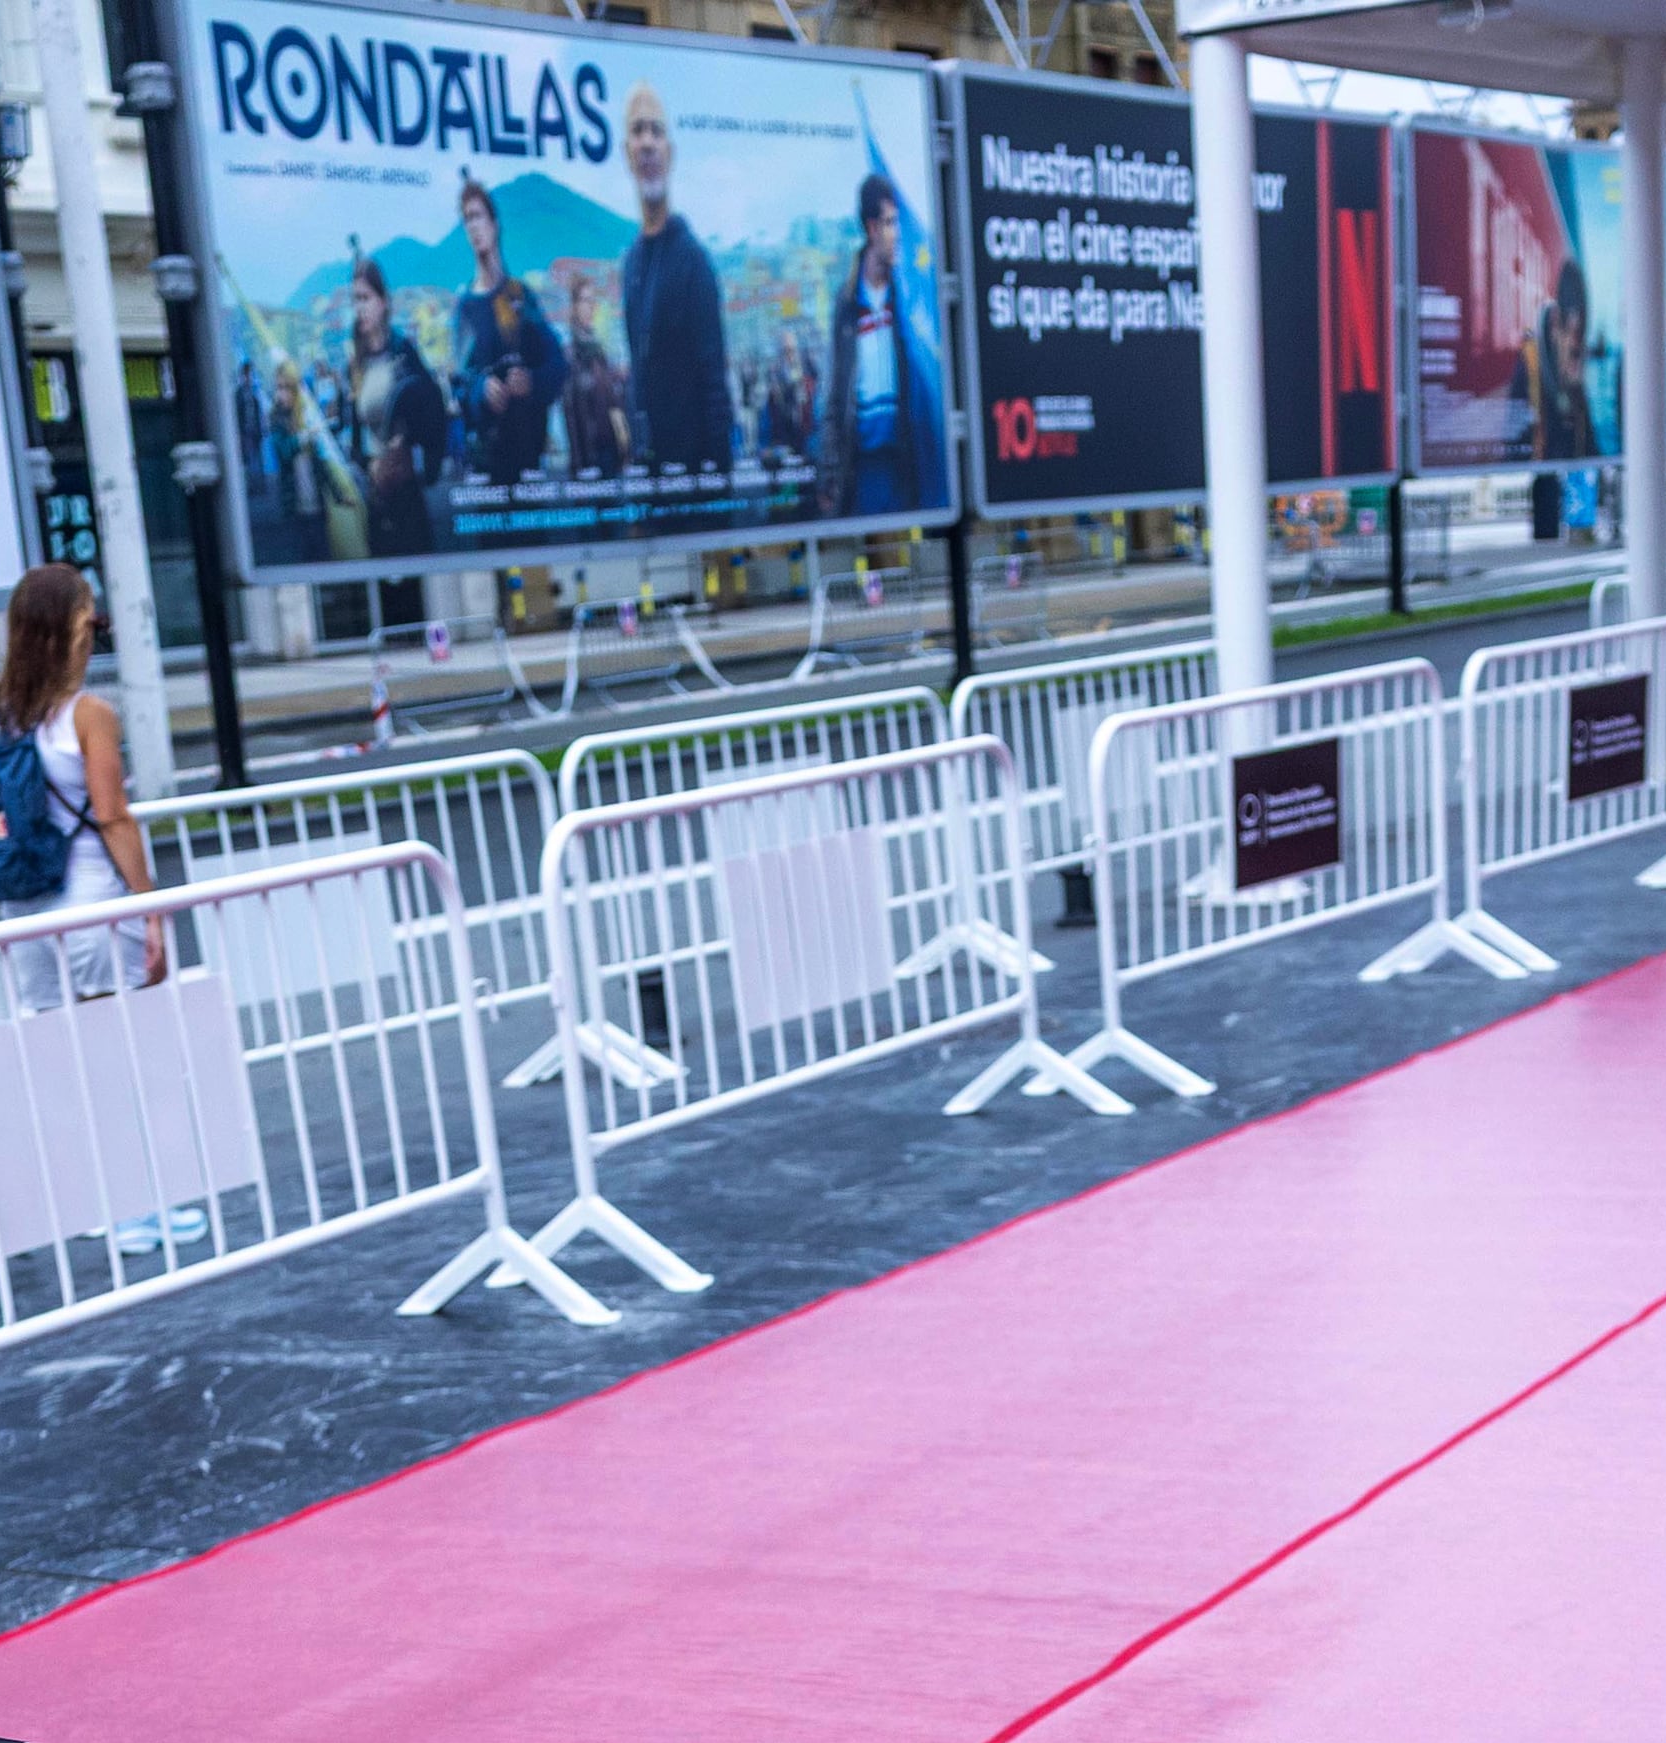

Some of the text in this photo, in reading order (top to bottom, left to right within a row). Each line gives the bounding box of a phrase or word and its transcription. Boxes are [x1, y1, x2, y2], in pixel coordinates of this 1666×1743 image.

[208, 19, 613, 165] RONDALLAS
[980, 133, 1094, 199] Nuestra
[1093, 142, 1193, 207] historia
[984, 214, 1043, 263] con
[1042, 206, 1072, 264] el
[1071, 207, 1131, 268] cine
[1017, 285, 1074, 343] que
[1073, 274, 1109, 331] da
[1109, 288, 1169, 344] para
[991, 396, 1036, 462] 10
